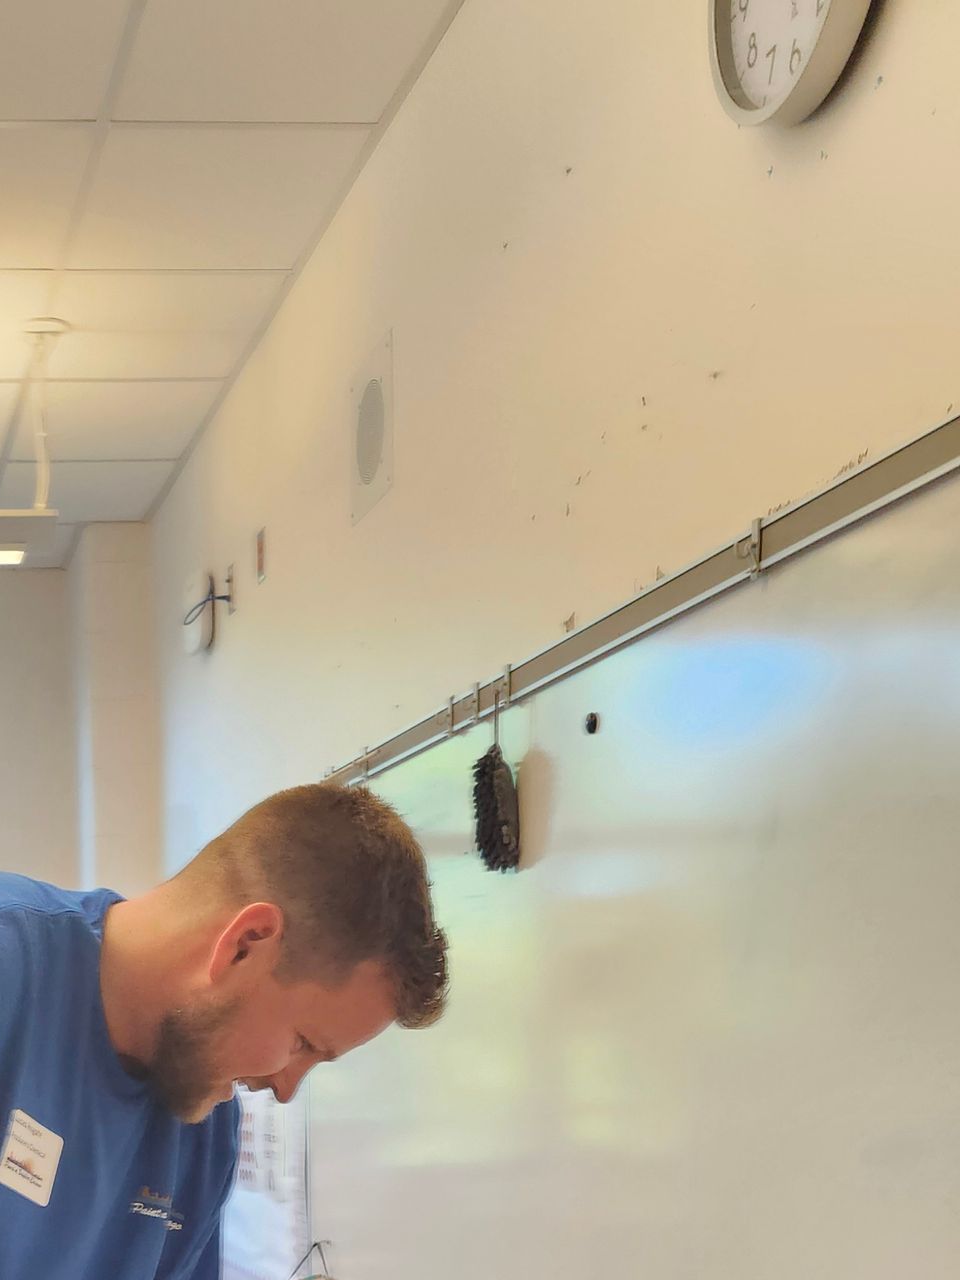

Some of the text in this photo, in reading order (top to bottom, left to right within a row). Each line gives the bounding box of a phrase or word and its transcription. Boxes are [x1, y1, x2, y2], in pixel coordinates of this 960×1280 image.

[747, 32, 758, 68] 8
[766, 44, 777, 85] 7
[789, 38, 801, 75] 6
